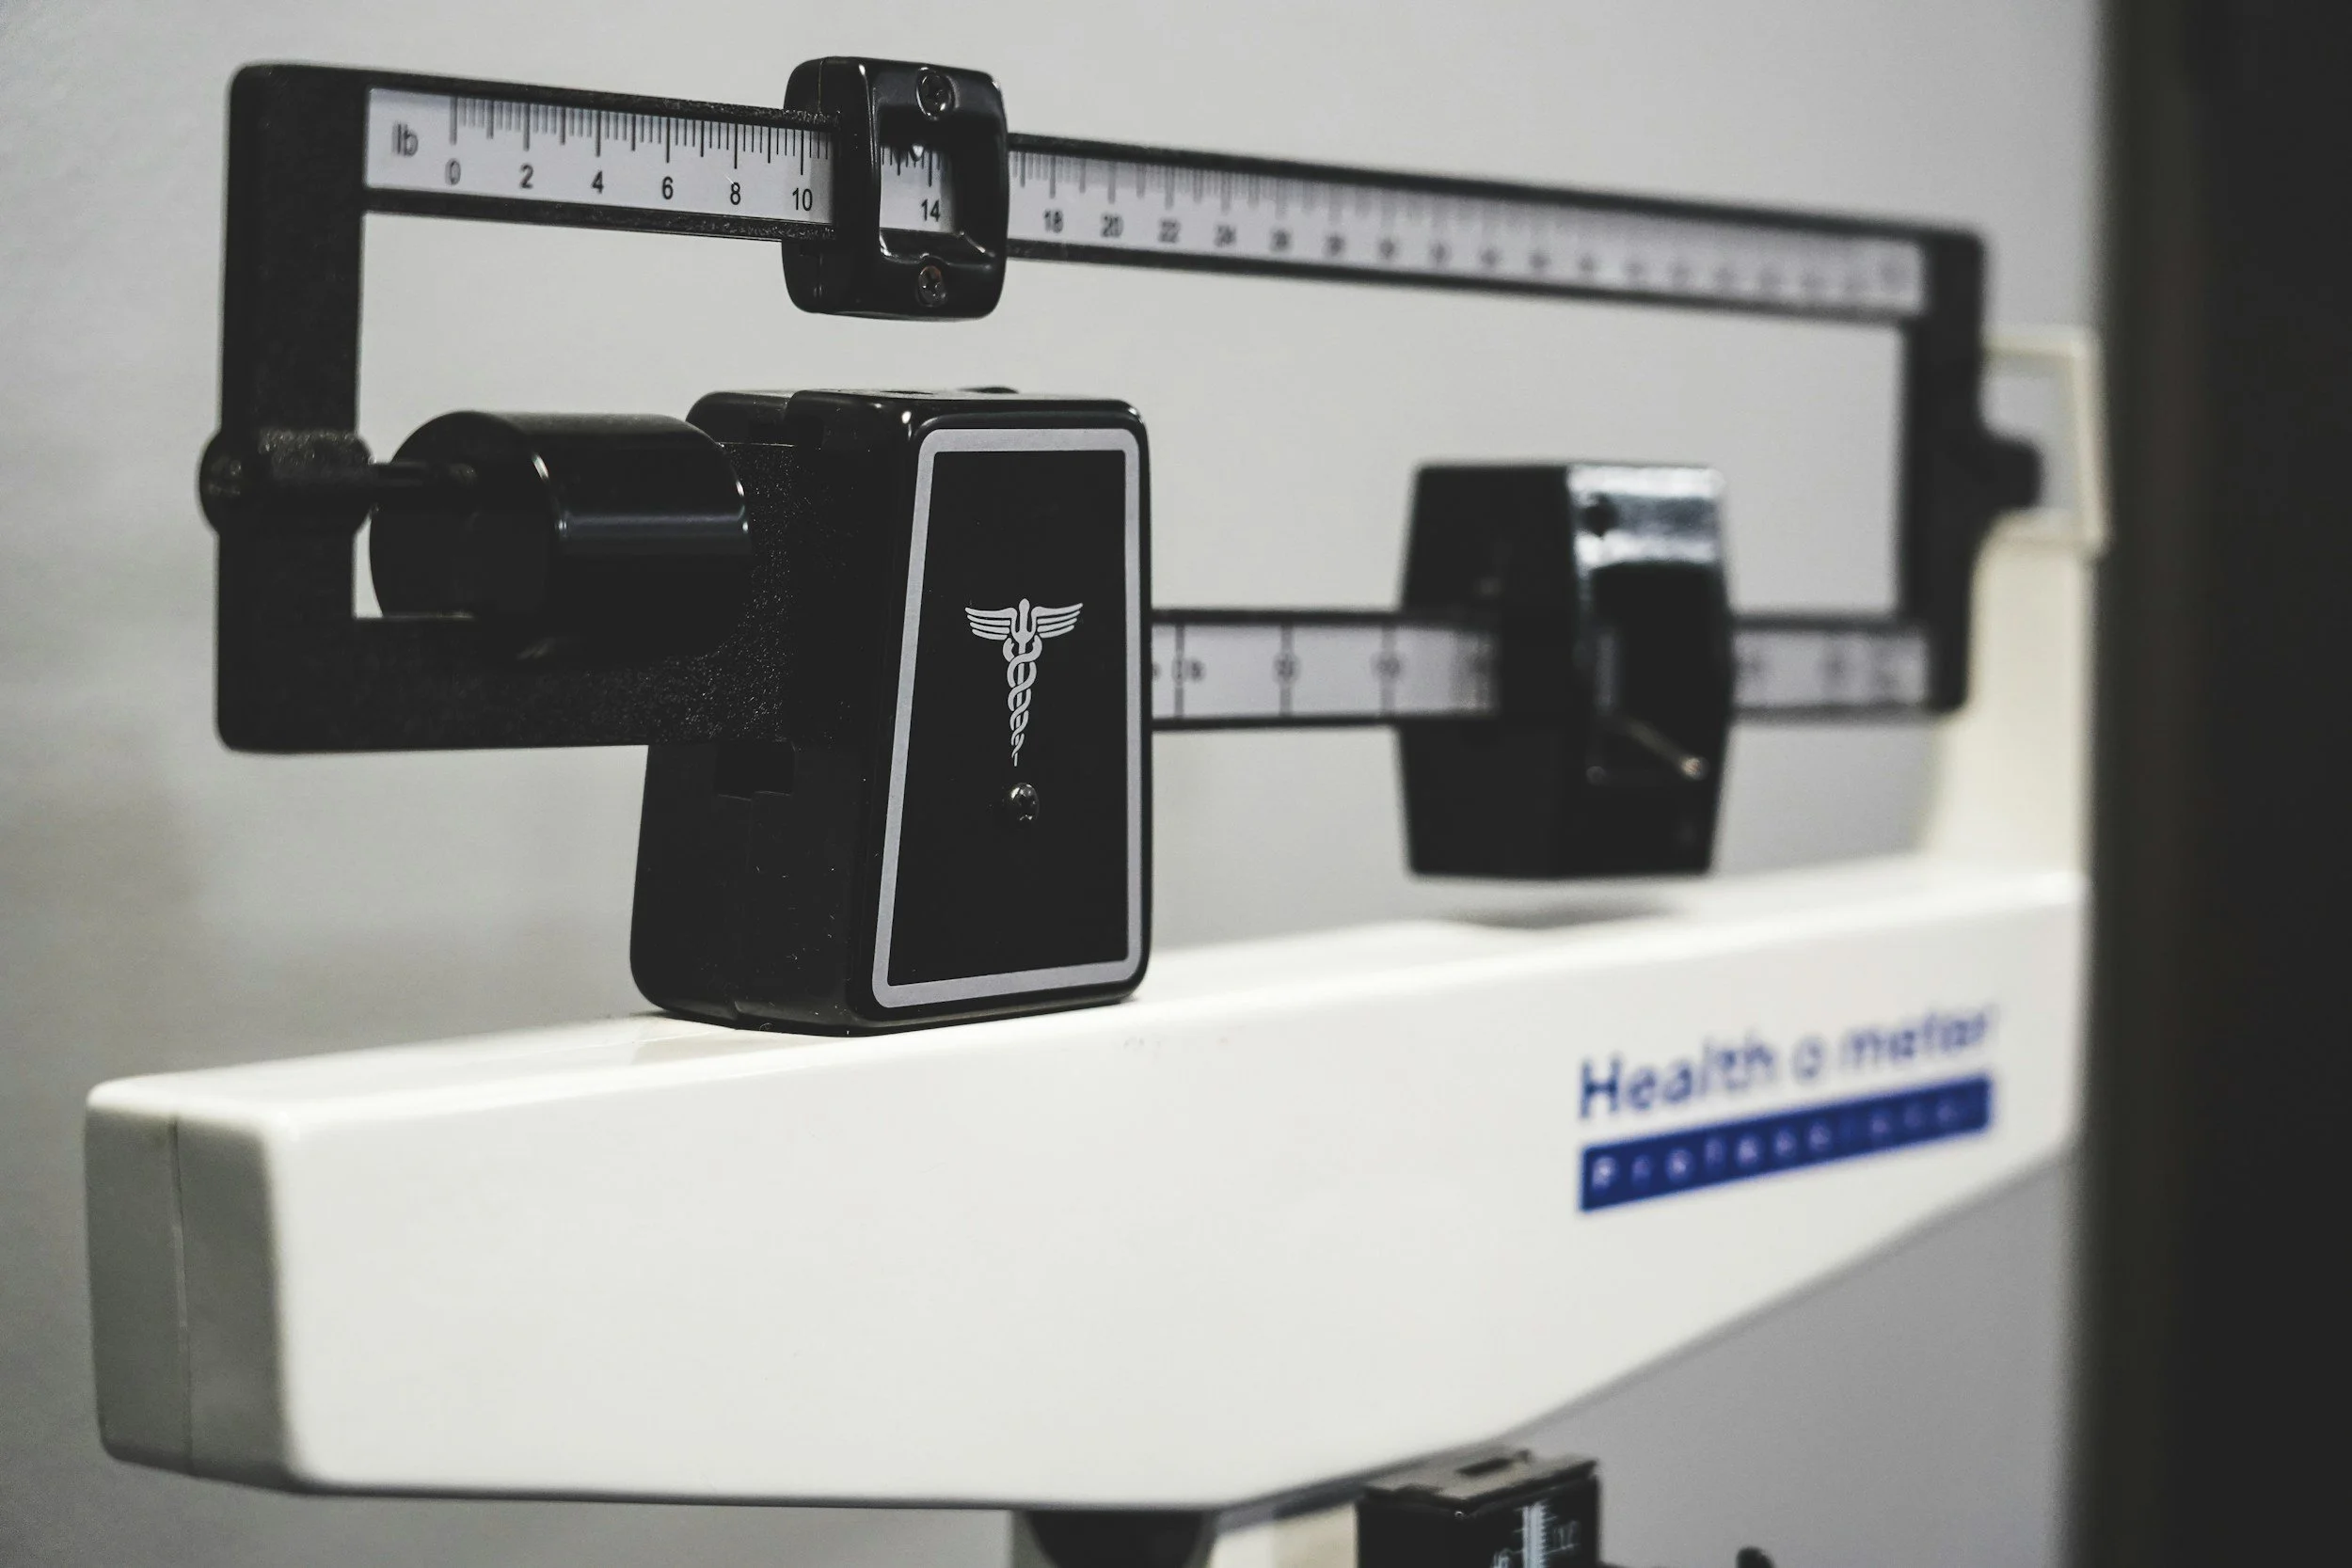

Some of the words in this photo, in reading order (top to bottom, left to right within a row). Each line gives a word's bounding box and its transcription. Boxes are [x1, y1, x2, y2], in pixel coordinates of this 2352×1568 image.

[392, 122, 419, 157] lb
[444, 158, 461, 186] 0
[519, 163, 533, 189] 2
[591, 170, 604, 195] 4
[661, 176, 675, 200] 6
[729, 182, 741, 206] 8
[791, 188, 813, 212] 10
[920, 198, 941, 222] 14
[1043, 209, 1064, 234] 18
[1100, 212, 1124, 238] 20
[1580, 1033, 1776, 1119] Health
[1792, 1035, 1826, 1082] o
